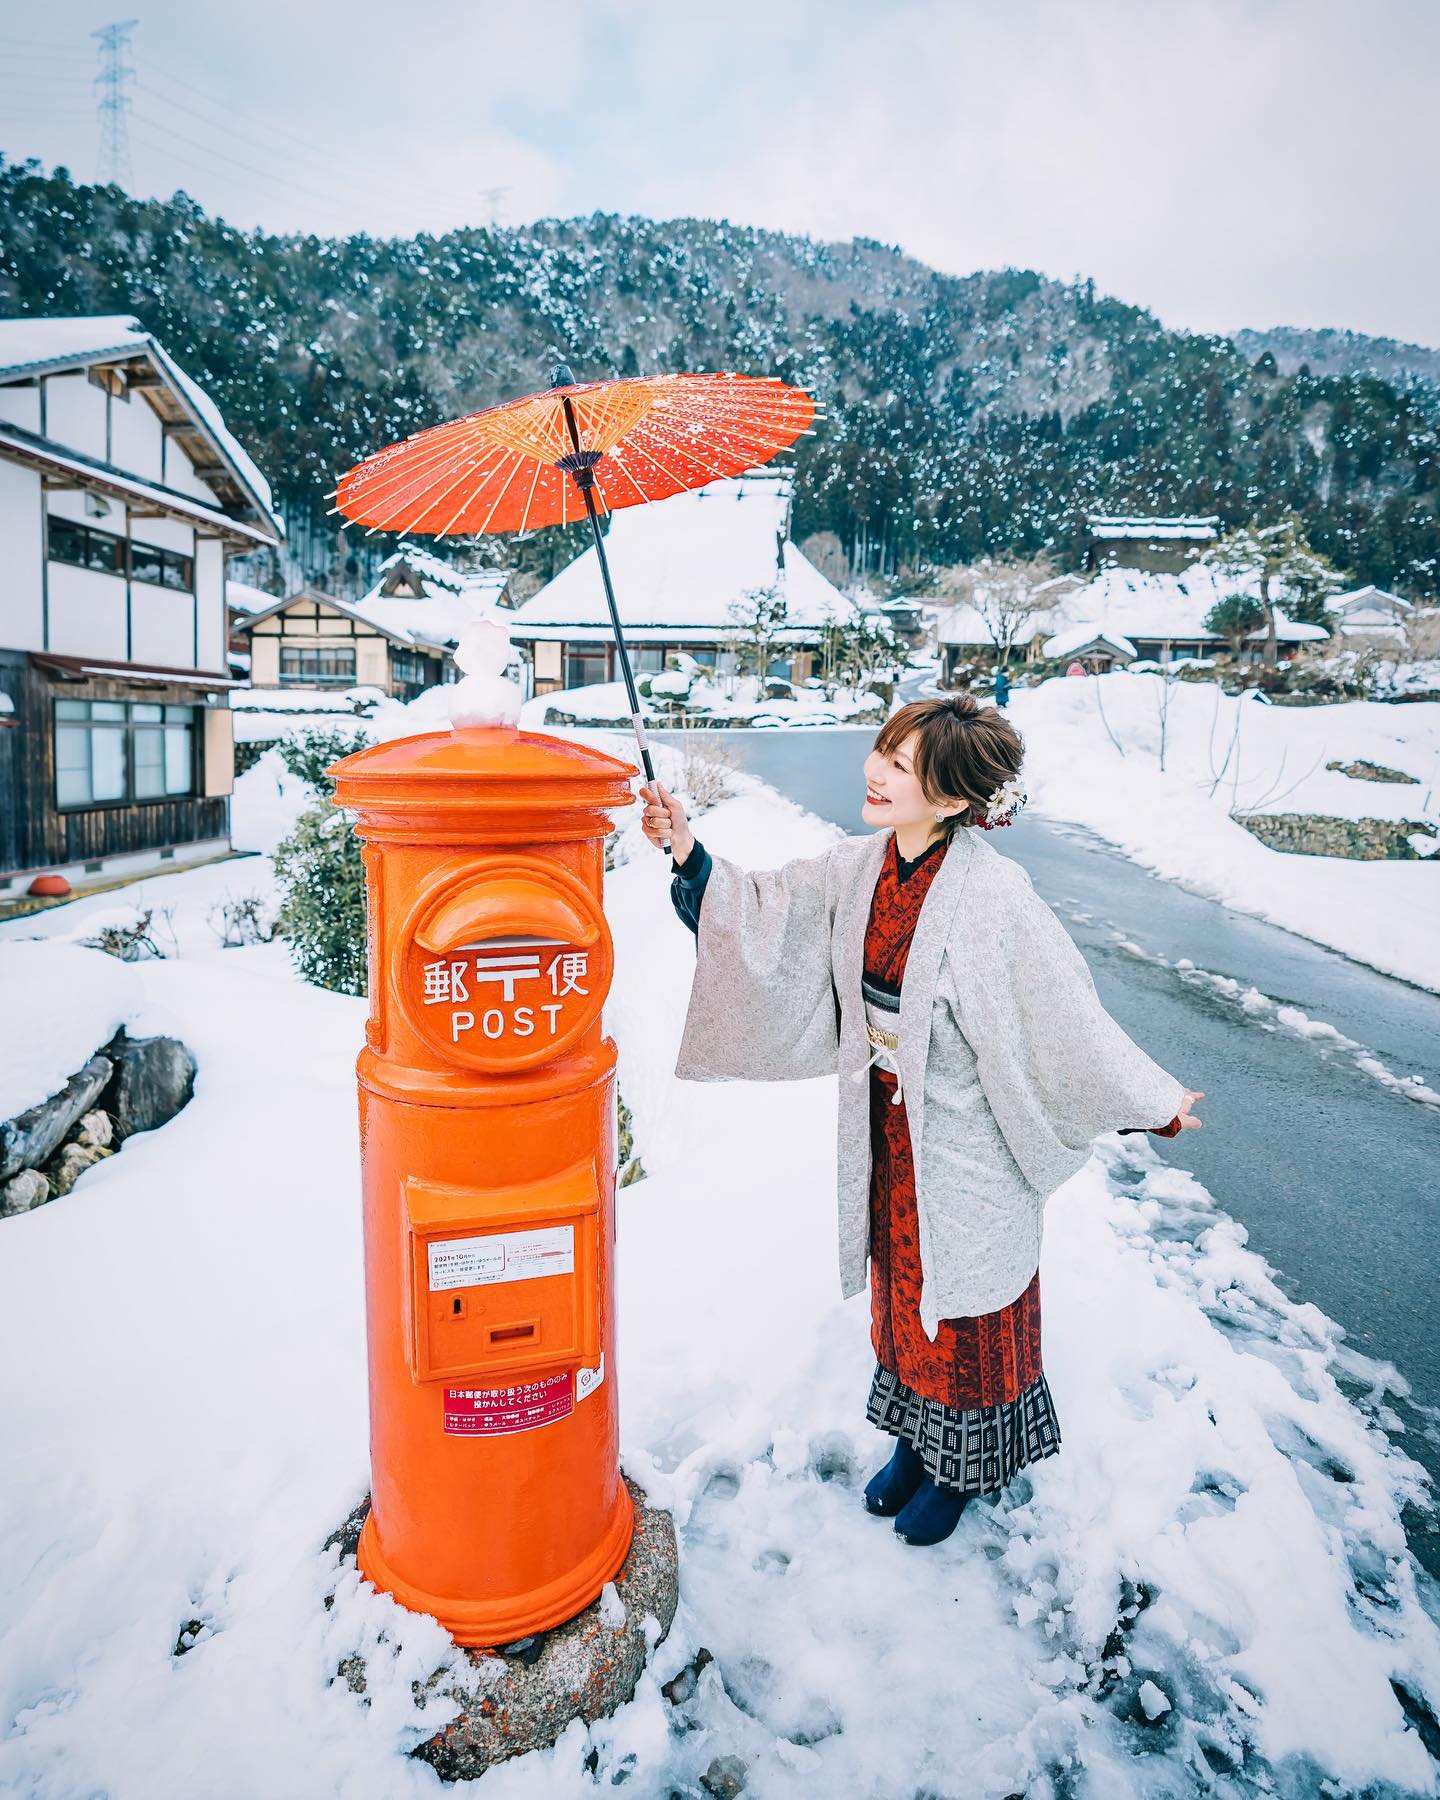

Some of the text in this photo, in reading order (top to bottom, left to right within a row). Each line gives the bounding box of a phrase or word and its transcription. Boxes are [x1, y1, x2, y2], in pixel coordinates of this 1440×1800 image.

[452, 1004, 563, 1042] POST
[449, 1373, 568, 1399] 日本郵便が取り扱う次のもののみ
[473, 1391, 547, 1409] 投かんしてください
